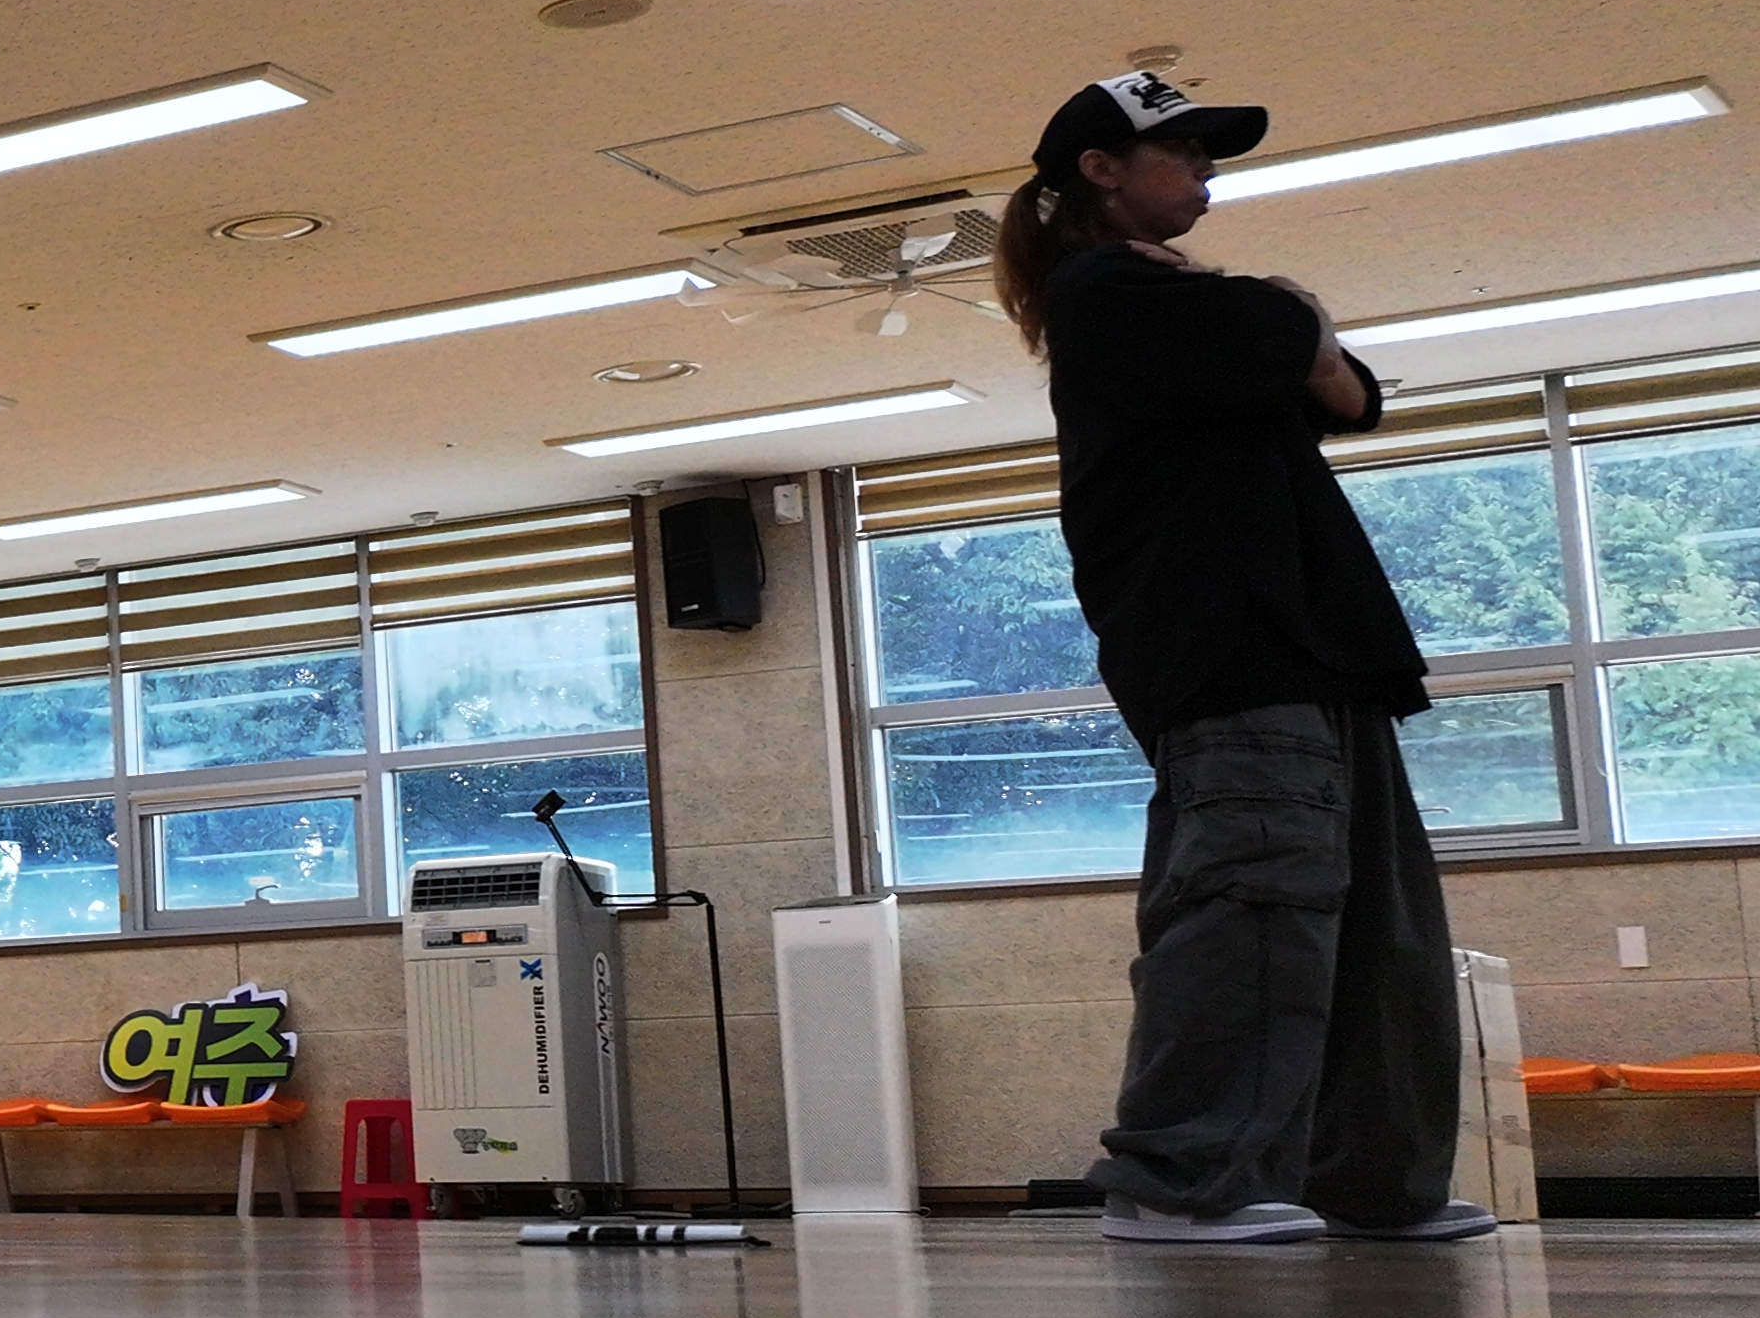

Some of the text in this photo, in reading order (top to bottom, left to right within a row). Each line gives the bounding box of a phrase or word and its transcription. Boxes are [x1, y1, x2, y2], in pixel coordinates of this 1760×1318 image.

[108, 1006, 289, 1107] 여주
[533, 985, 550, 1094] DEHUMIDIFIER
[596, 957, 611, 1055] NAWOO
